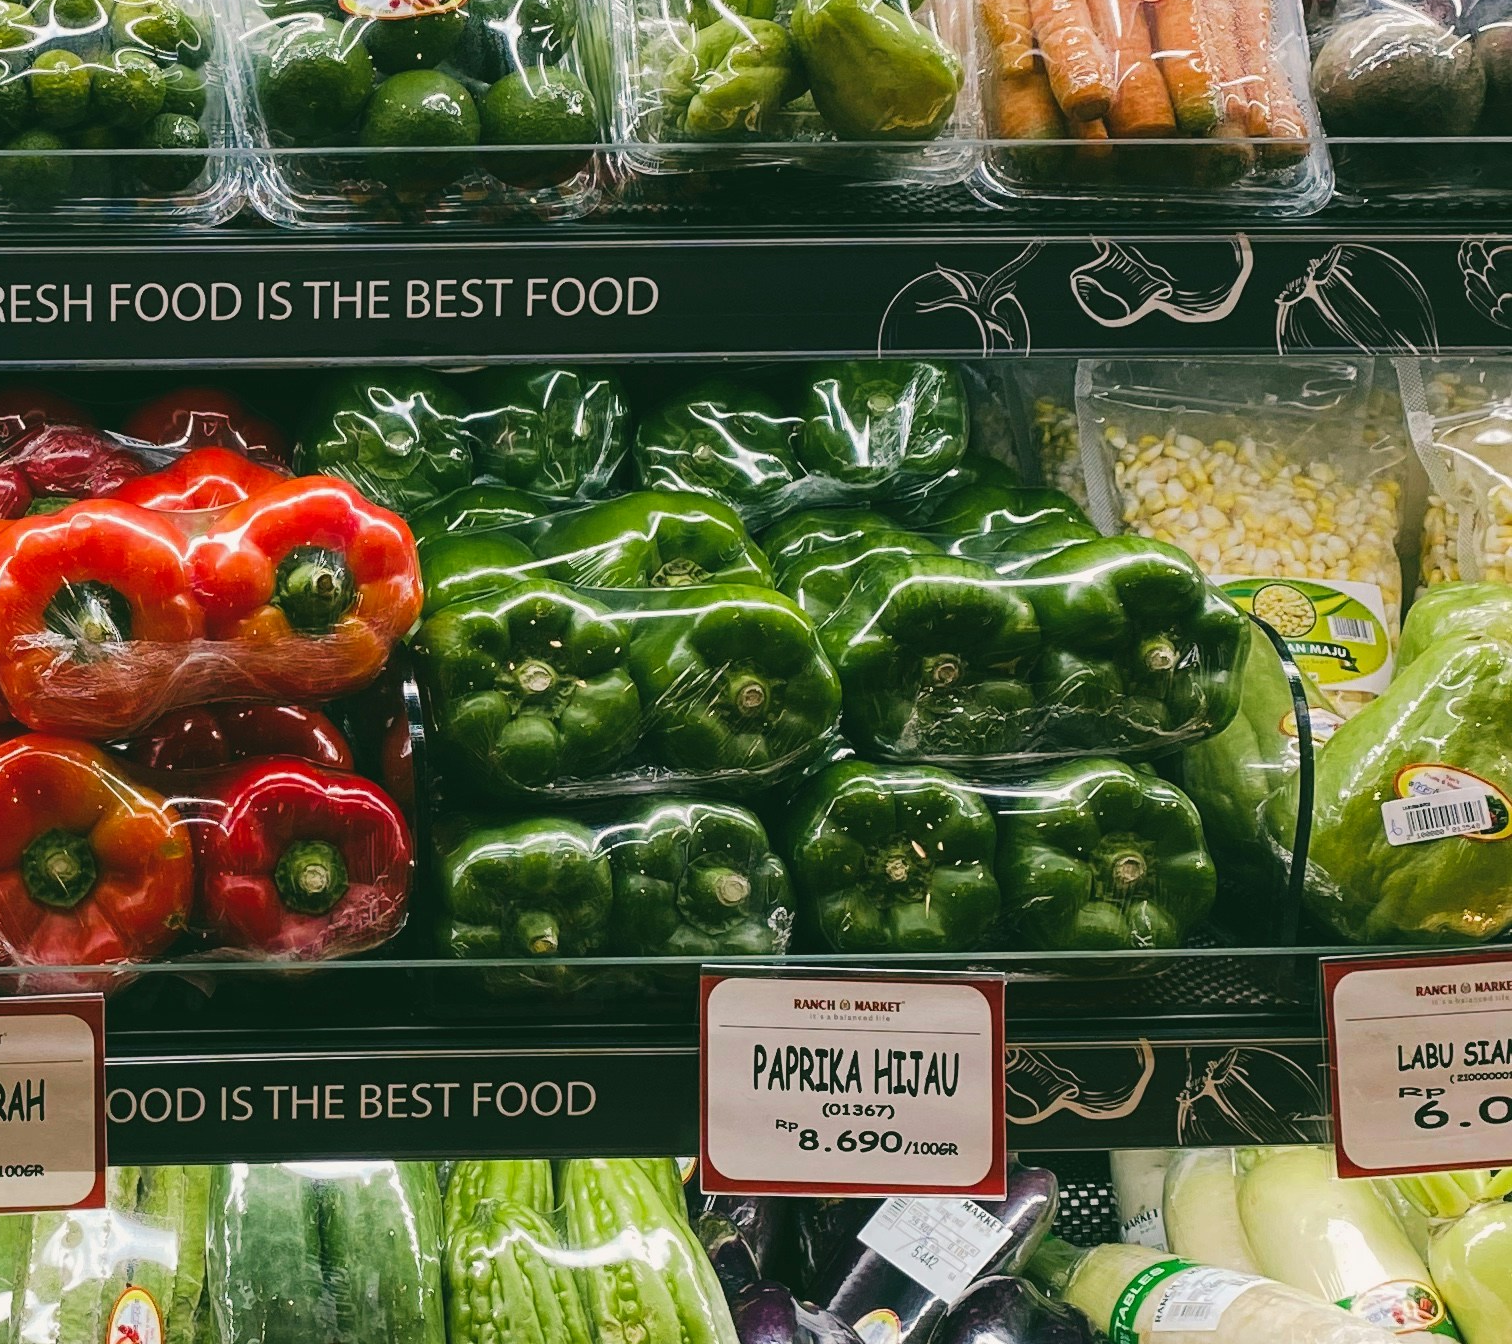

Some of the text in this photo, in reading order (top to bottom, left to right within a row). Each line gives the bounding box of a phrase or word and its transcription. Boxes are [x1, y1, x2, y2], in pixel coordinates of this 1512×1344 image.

[110, 282, 243, 323] FOOD
[257, 281, 291, 322] IS
[303, 280, 390, 321] THE
[405, 278, 514, 319] BEST
[526, 276, 659, 318] FOOD
[1310, 644, 1347, 658] MAJU
[1415, 981, 1512, 997] RANCH MARKE
[794, 998, 902, 1013] RANCH MARKET
[753, 1044, 960, 1098] PAPRIKA HIJAU
[1397, 1042, 1454, 1072] LABU
[105, 1081, 597, 1124] OOD IS THE BEST FOOD
[822, 1103, 895, 1119] (01367)
[798, 1128, 903, 1154] 8.690
[904, 1141, 959, 1156] /100GR
